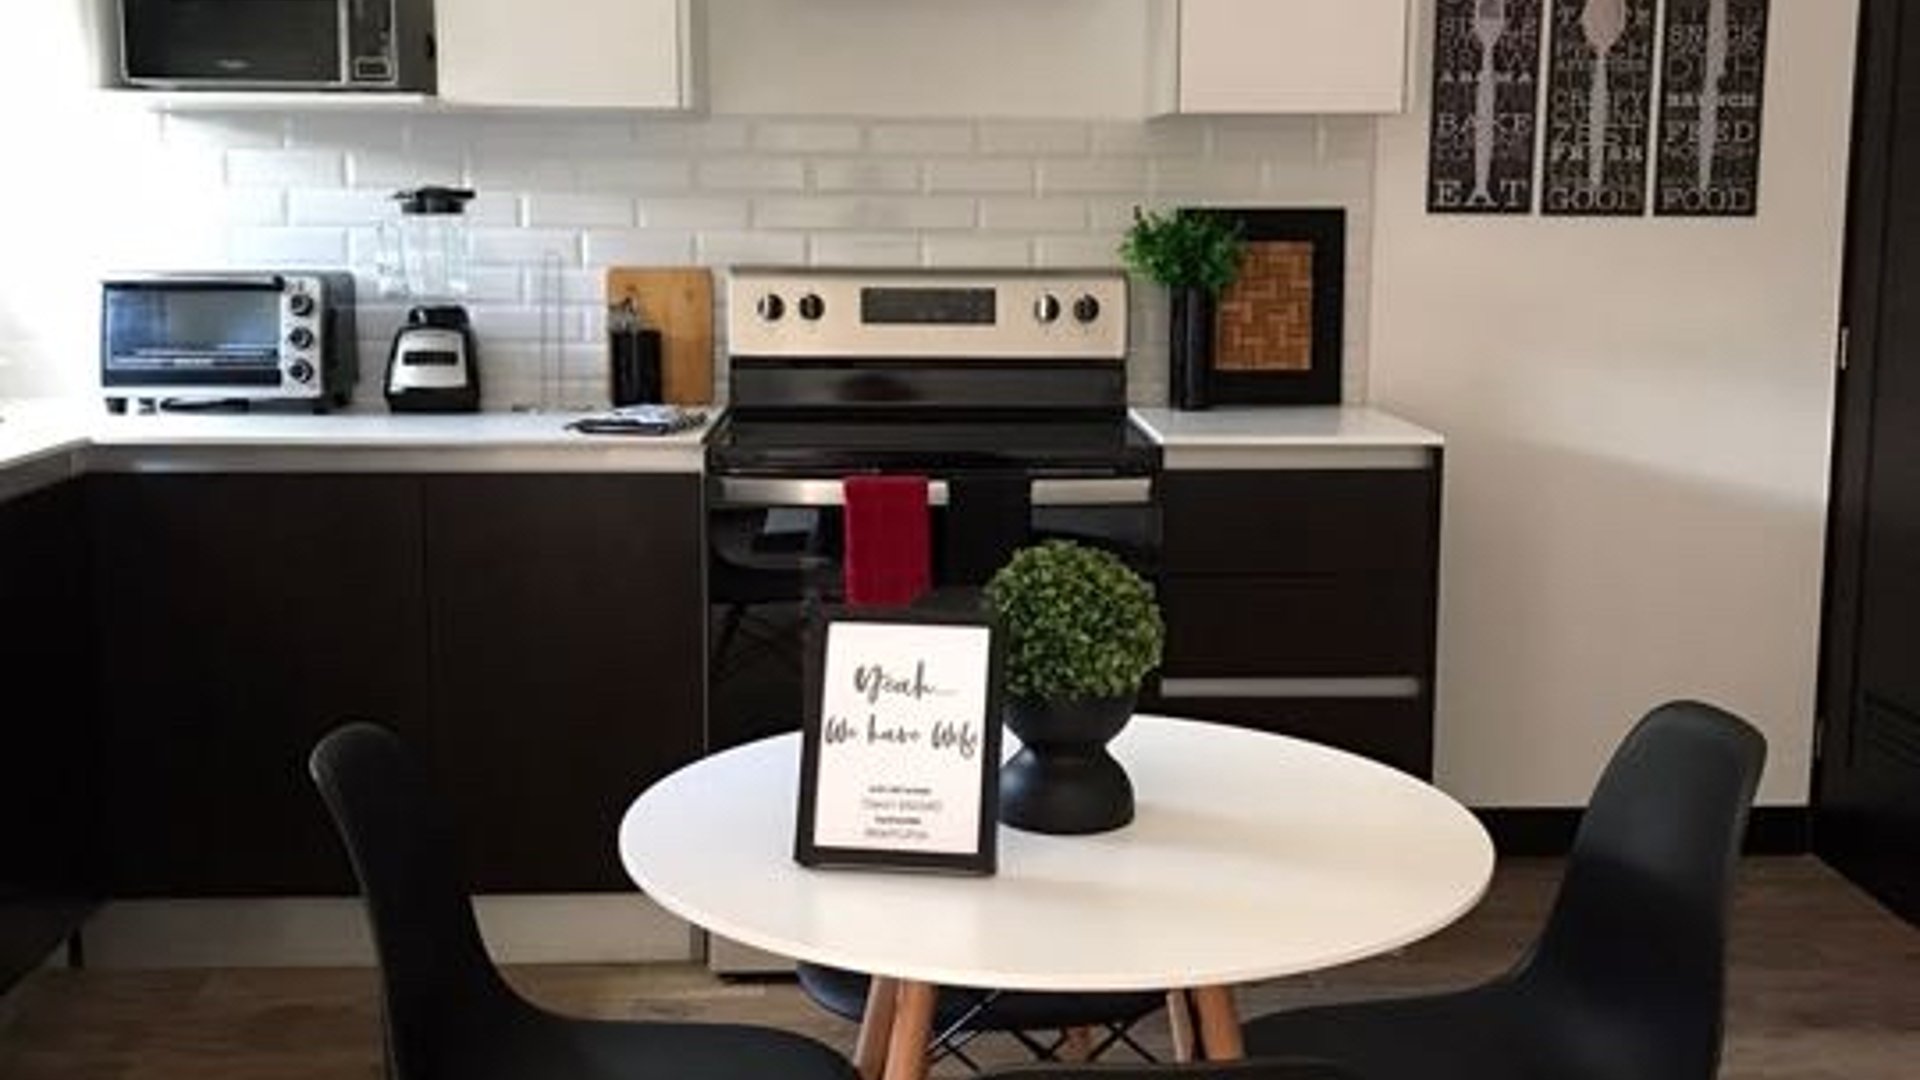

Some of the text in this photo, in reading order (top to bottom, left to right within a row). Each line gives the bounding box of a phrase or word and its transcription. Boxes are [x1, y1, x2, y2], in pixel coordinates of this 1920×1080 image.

[1668, 23, 1760, 50] SNCK
[1440, 71, 1532, 83] ARMA
[1550, 145, 1644, 161] FRSH
[1433, 180, 1529, 206] EAT
[1549, 187, 1643, 210] GOOD
[1662, 187, 1753, 210] FOOD
